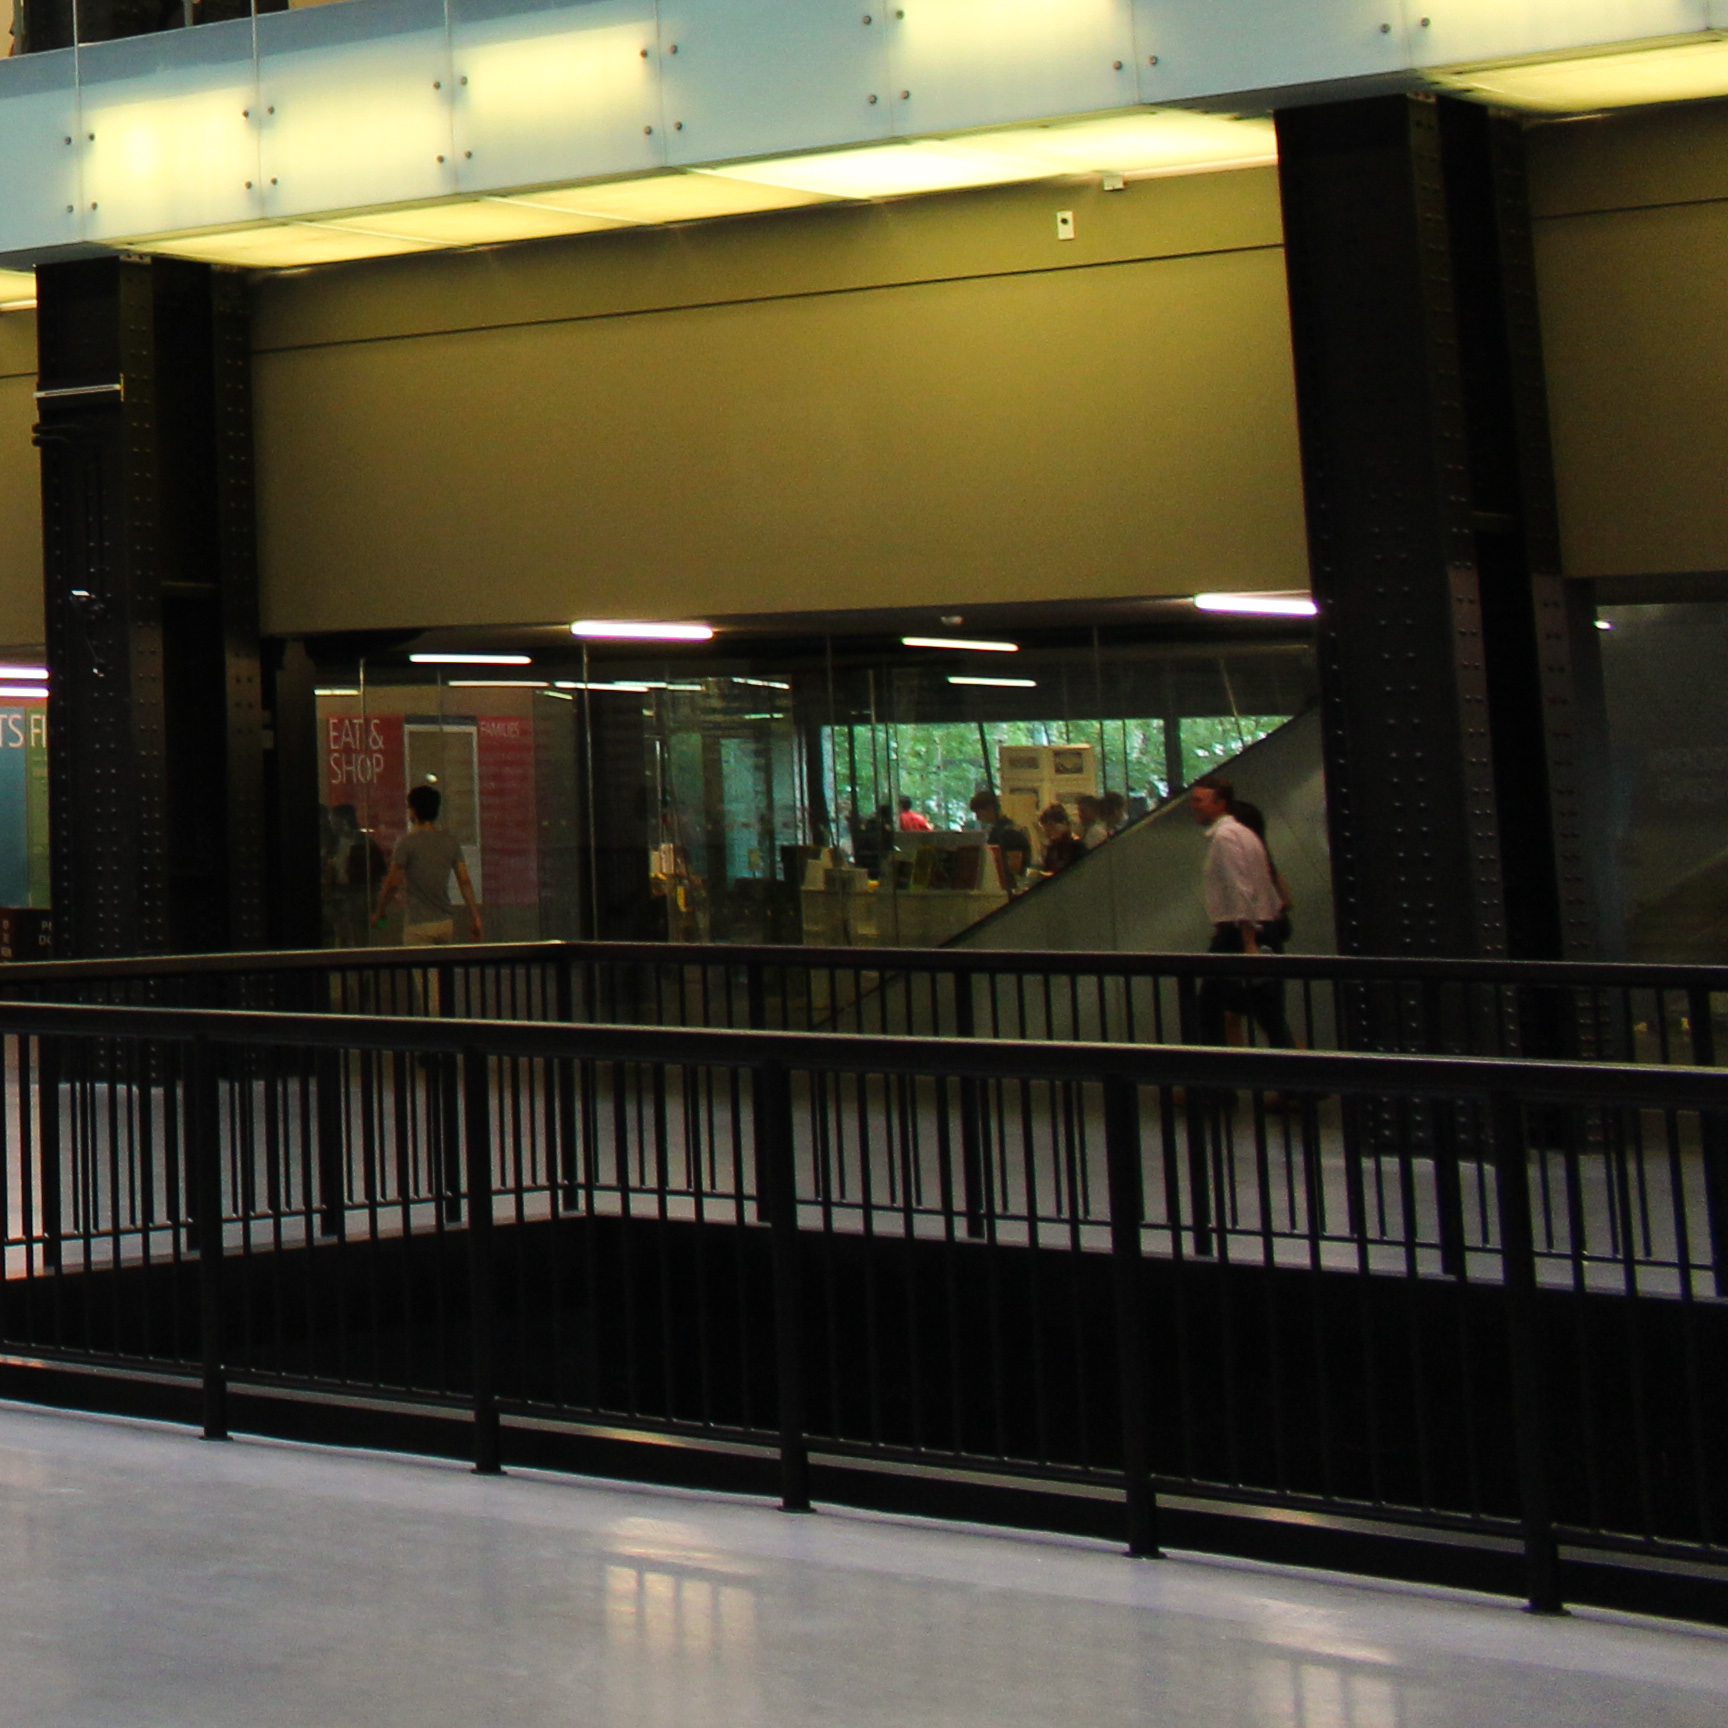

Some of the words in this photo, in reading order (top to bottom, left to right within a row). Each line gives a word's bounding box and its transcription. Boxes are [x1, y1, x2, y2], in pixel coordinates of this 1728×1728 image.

[329, 719, 362, 750] EAT
[369, 719, 385, 750] &
[329, 753, 384, 785] SHOP
